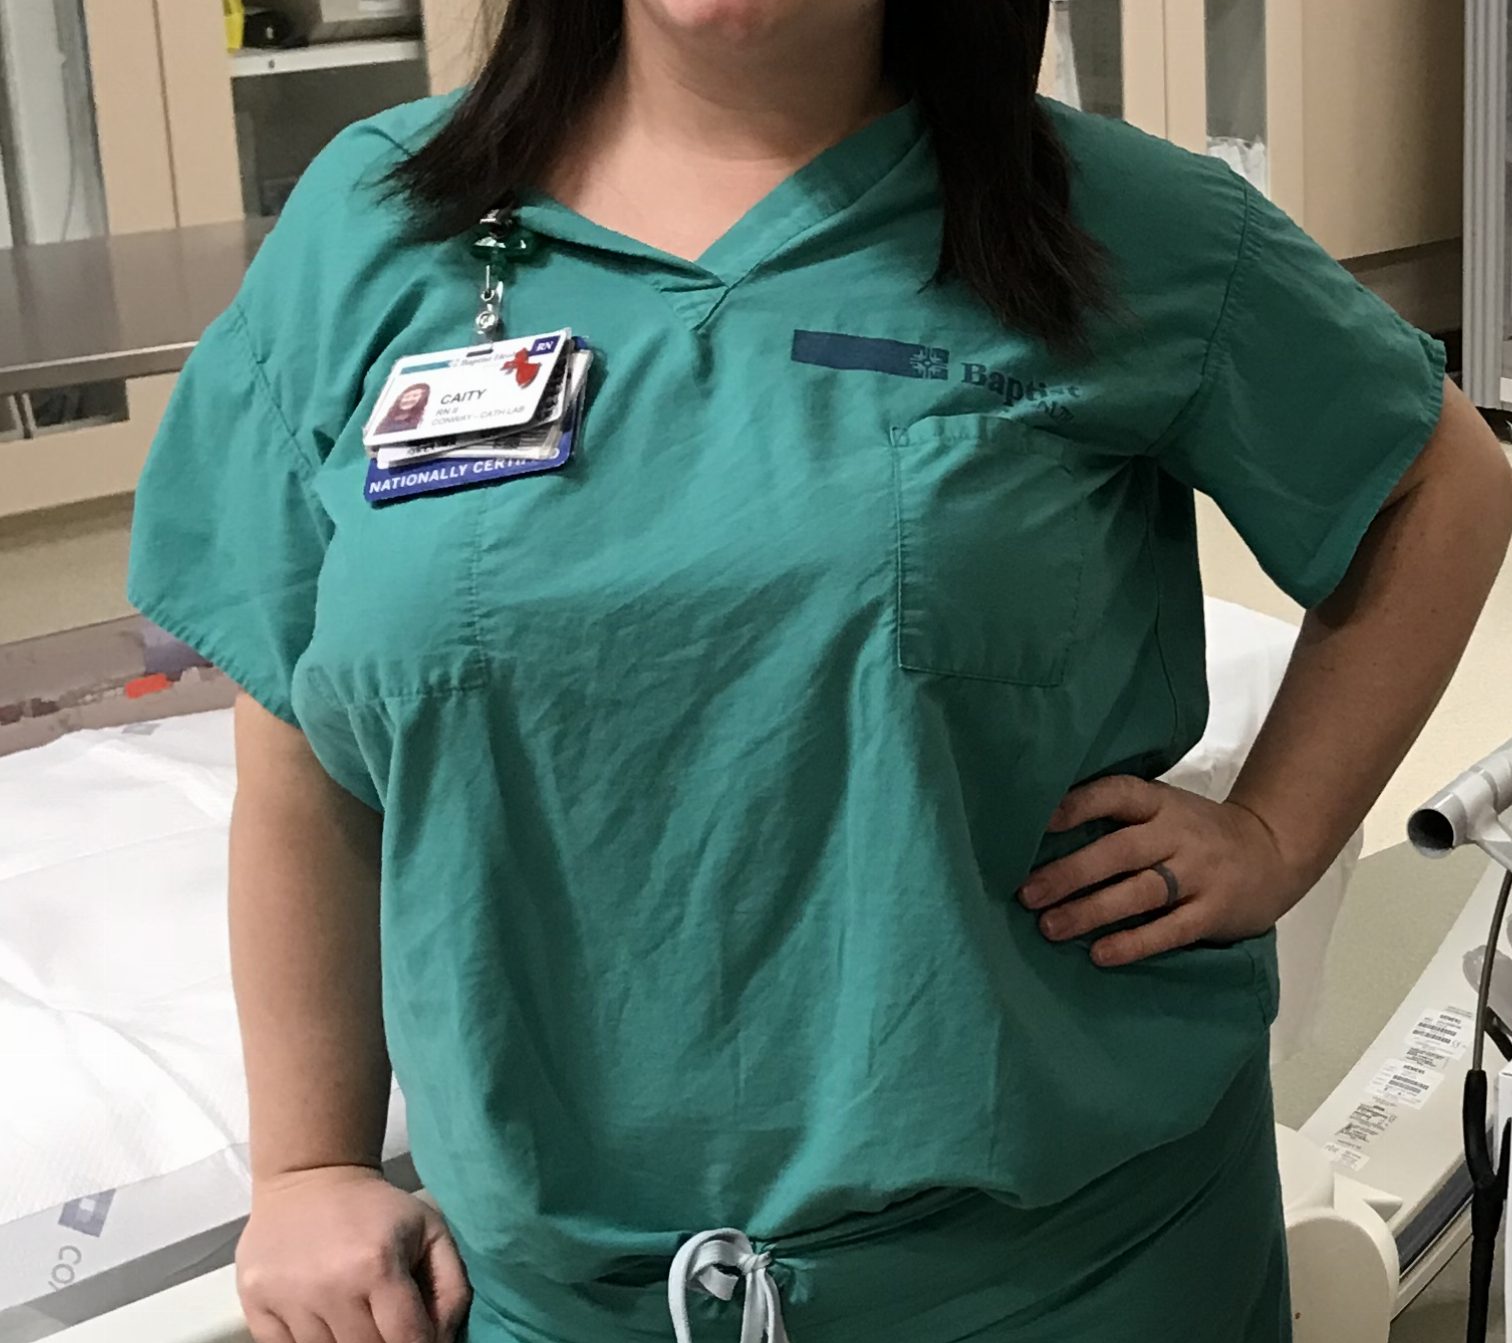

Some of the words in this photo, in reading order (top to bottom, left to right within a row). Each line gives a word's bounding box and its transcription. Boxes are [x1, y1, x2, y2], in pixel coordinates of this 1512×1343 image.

[535, 340, 556, 352] RN
[440, 388, 487, 406] CAITY
[368, 464, 467, 494] NATIONALLY
